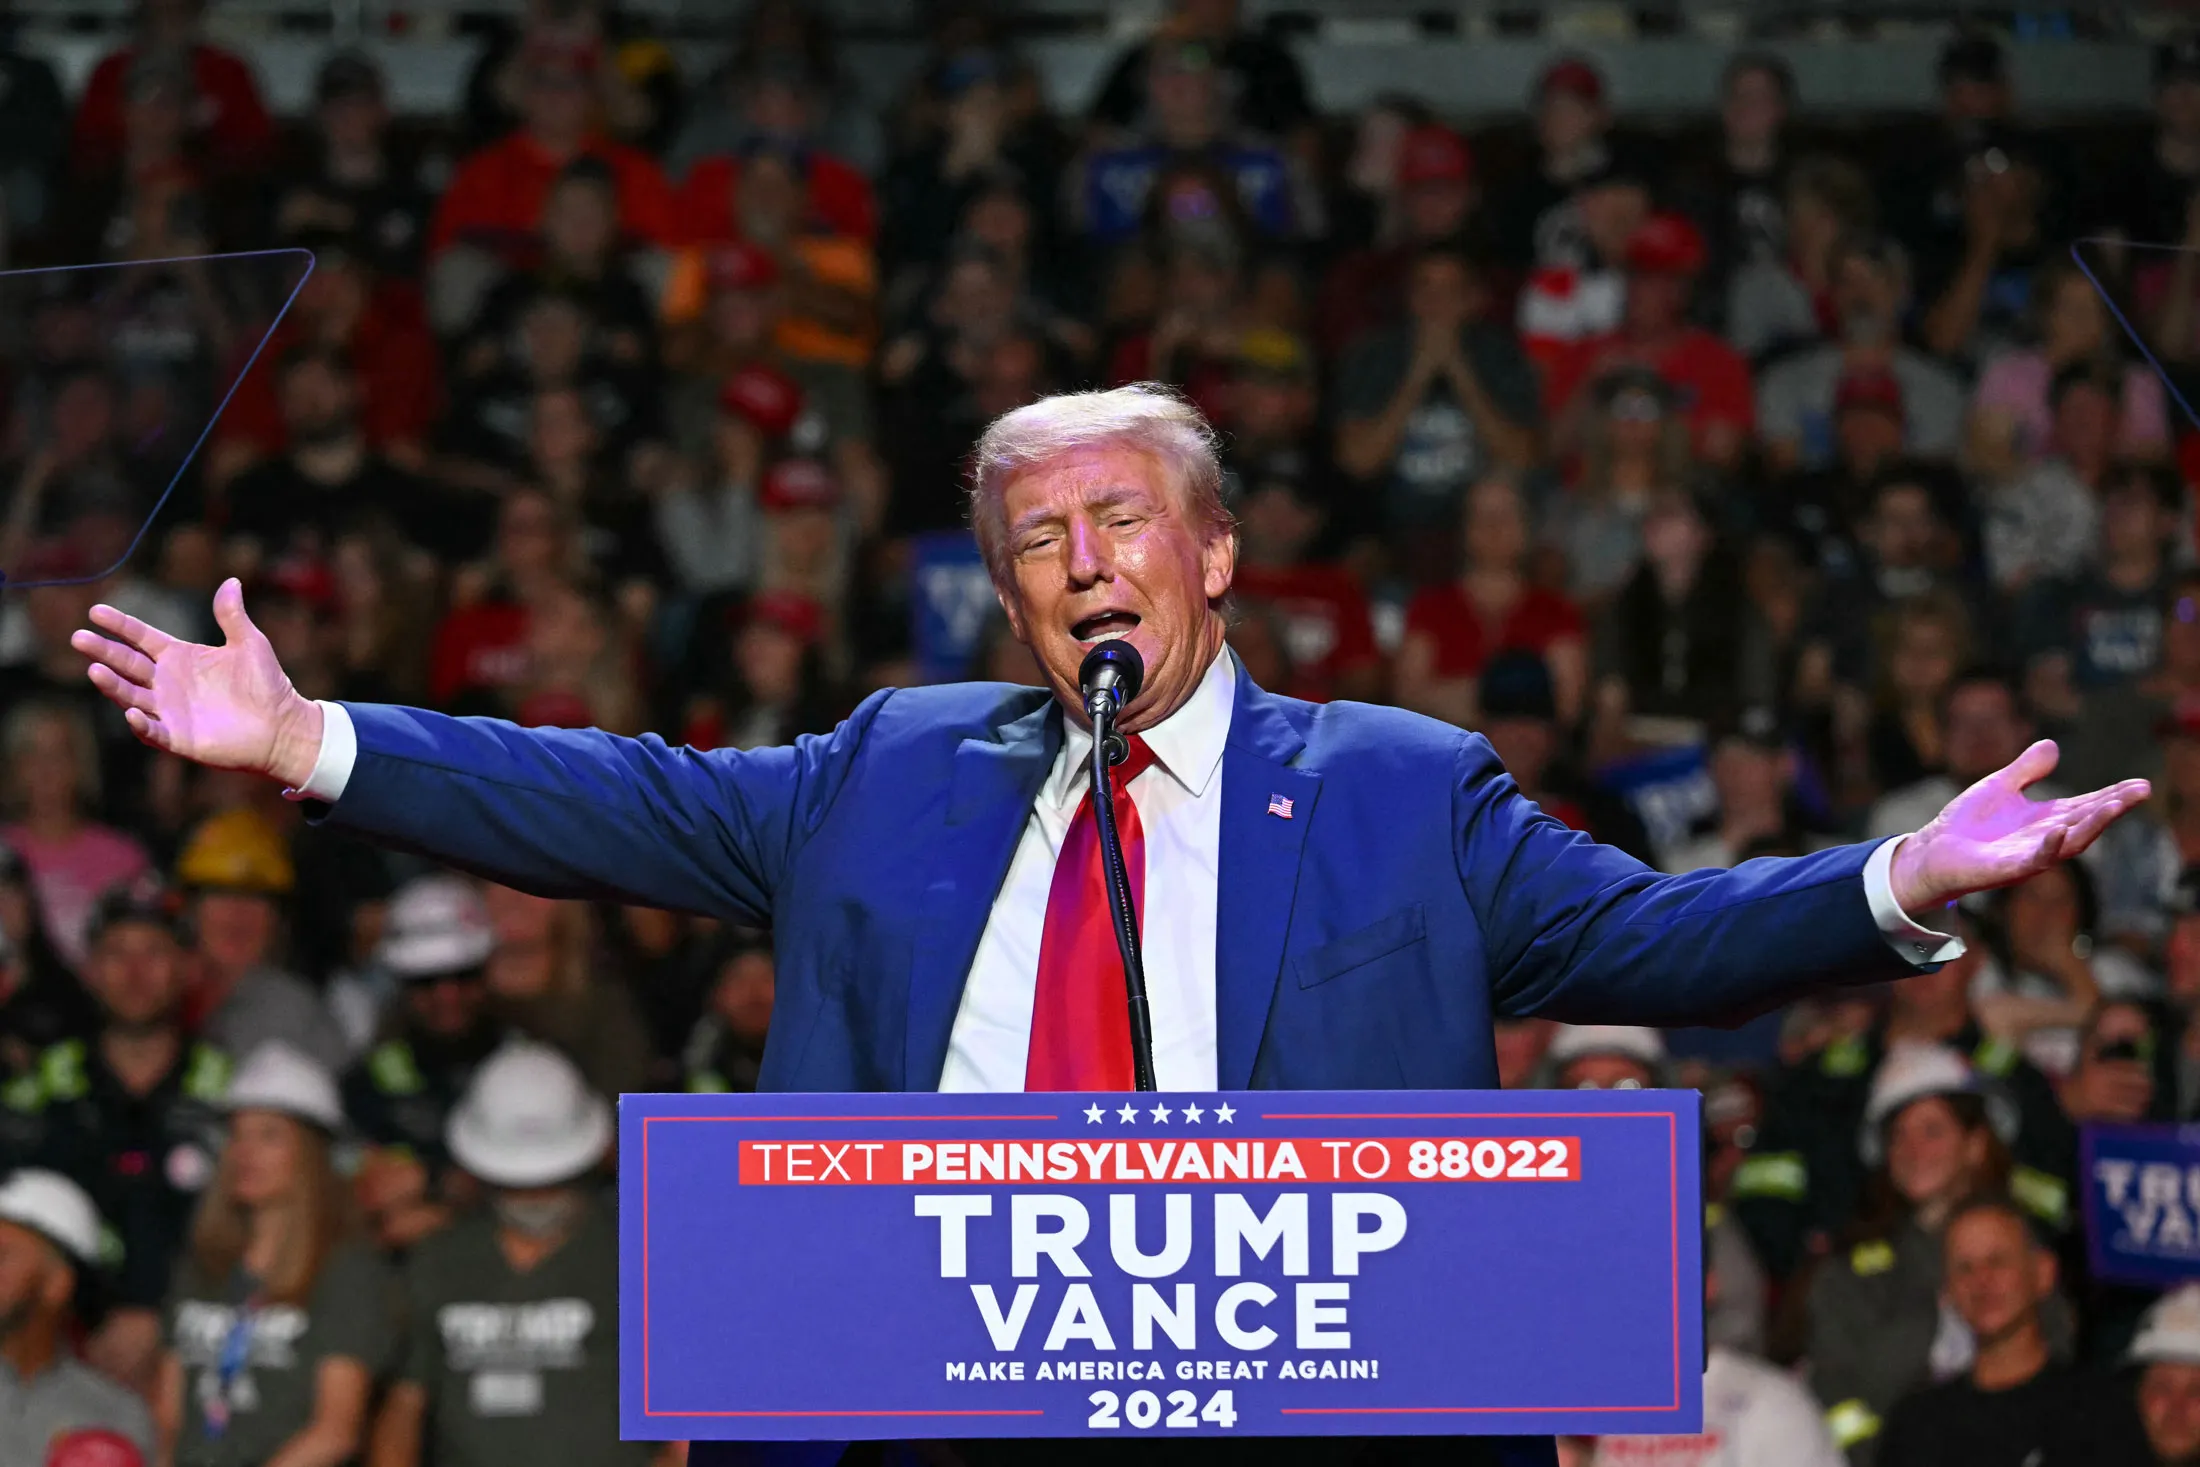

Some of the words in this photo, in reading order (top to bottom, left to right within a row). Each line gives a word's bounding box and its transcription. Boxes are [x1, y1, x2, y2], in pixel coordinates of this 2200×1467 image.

[752, 1143, 885, 1181] TEXT
[902, 1142, 1308, 1181] PENNSYLVANIA
[1321, 1140, 1391, 1179] TO
[1407, 1139, 1570, 1179] 88022
[914, 1192, 1408, 1279] TRUMP
[969, 1281, 1352, 1352] VANCE
[945, 1361, 1025, 1381] MAKE
[1035, 1360, 1166, 1381] AMERICA
[1175, 1360, 1269, 1380] GREAT
[1278, 1359, 1379, 1380] AGAIN!
[1088, 1389, 1238, 1429] 2024
